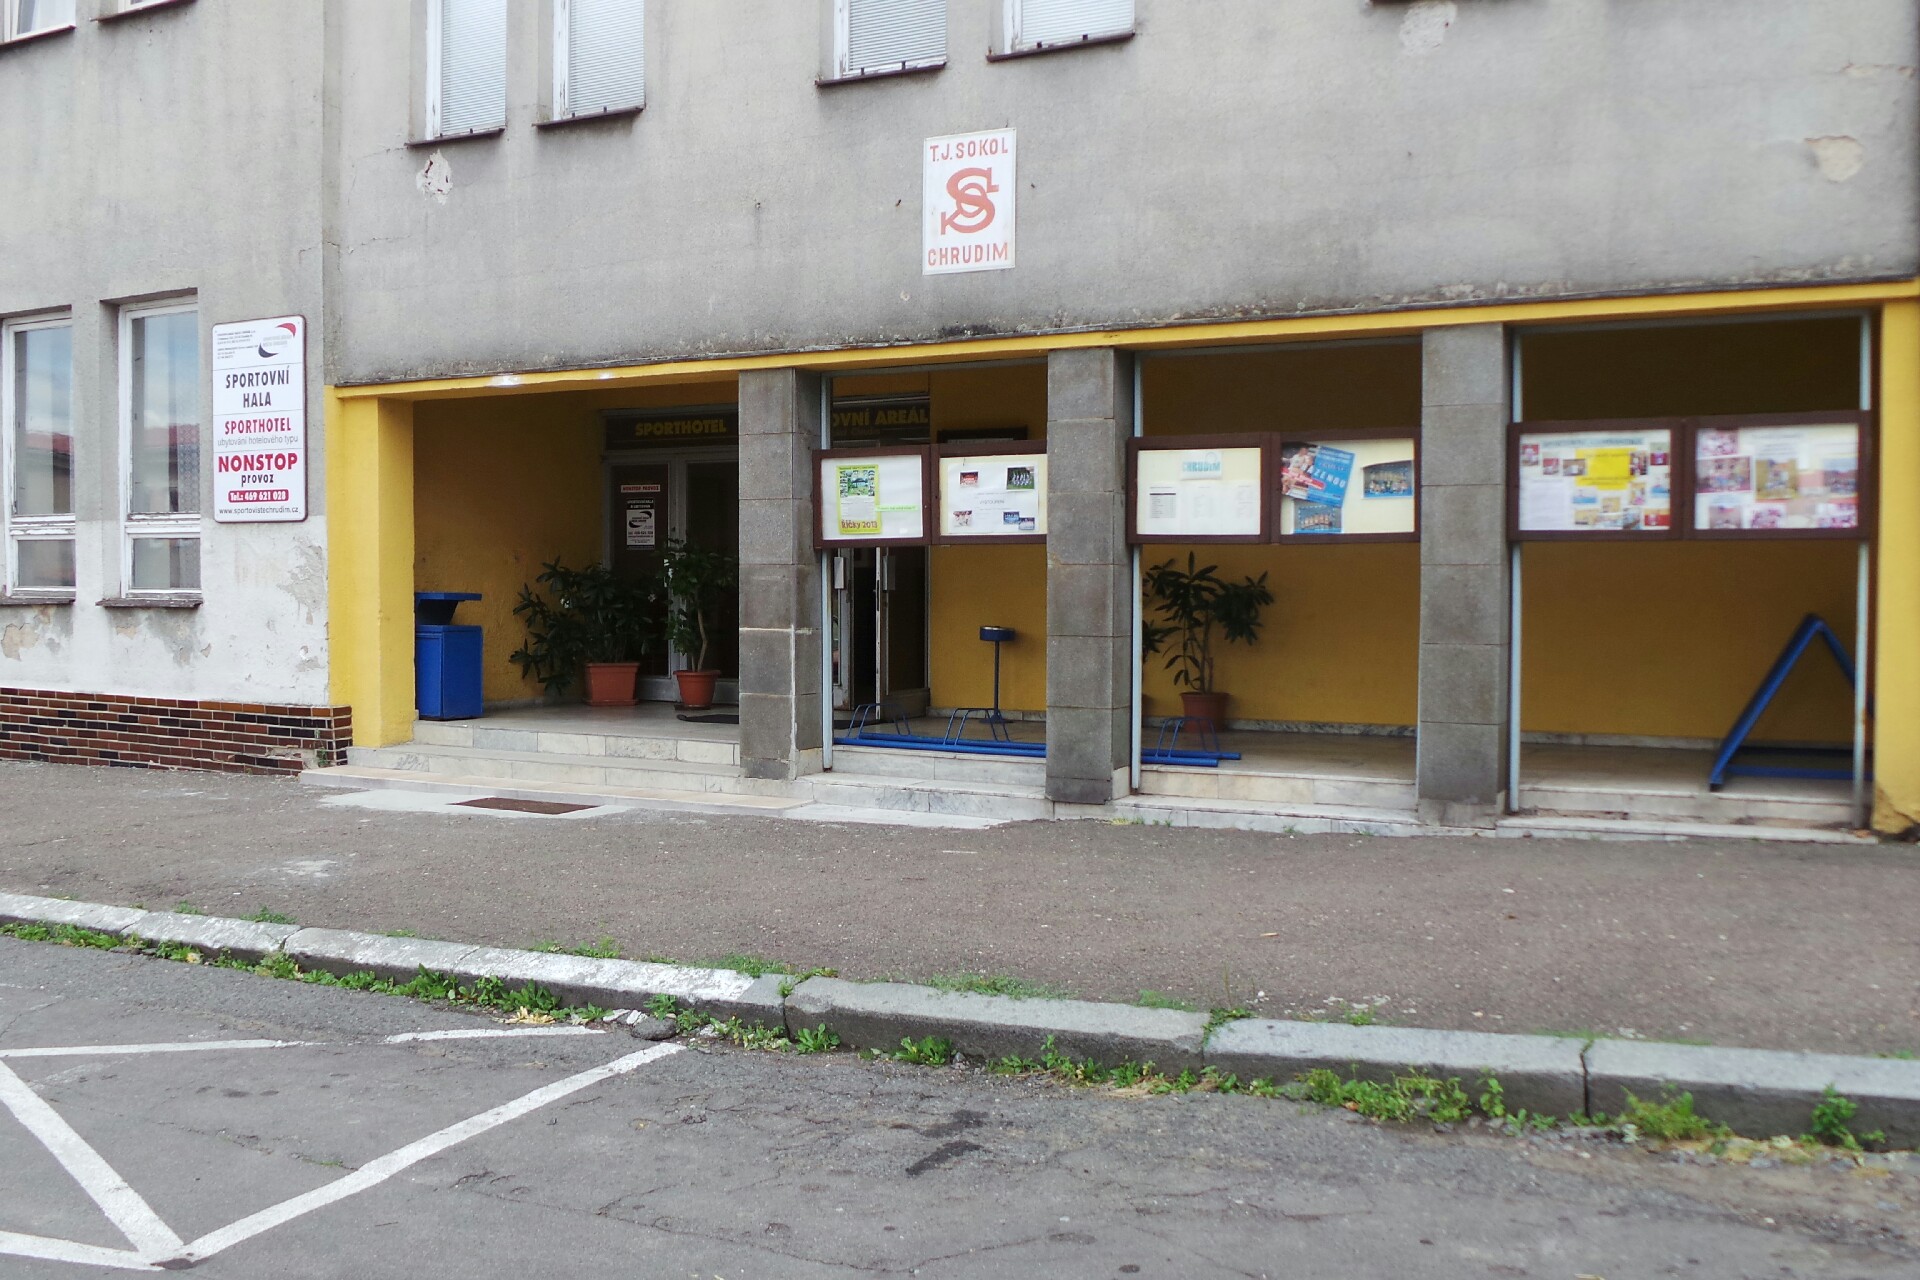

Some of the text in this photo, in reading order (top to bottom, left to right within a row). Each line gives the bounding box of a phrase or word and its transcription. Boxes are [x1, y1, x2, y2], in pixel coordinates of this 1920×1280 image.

[928, 242, 1008, 266] CHRUDIM
[226, 366, 290, 389] SPORTOVNÍ
[243, 392, 272, 408] HALA
[875, 406, 929, 425] AREÁL
[225, 417, 292, 434] SPORTHOTEL
[635, 419, 728, 436] SPORTHOTEL
[218, 434, 298, 448] ubytování hotelového typu
[218, 452, 298, 473] NONSTOP
[241, 474, 274, 488] provoz
[244, 492, 258, 501] 469
[258, 492, 271, 500] 621
[272, 490, 286, 500] 028
